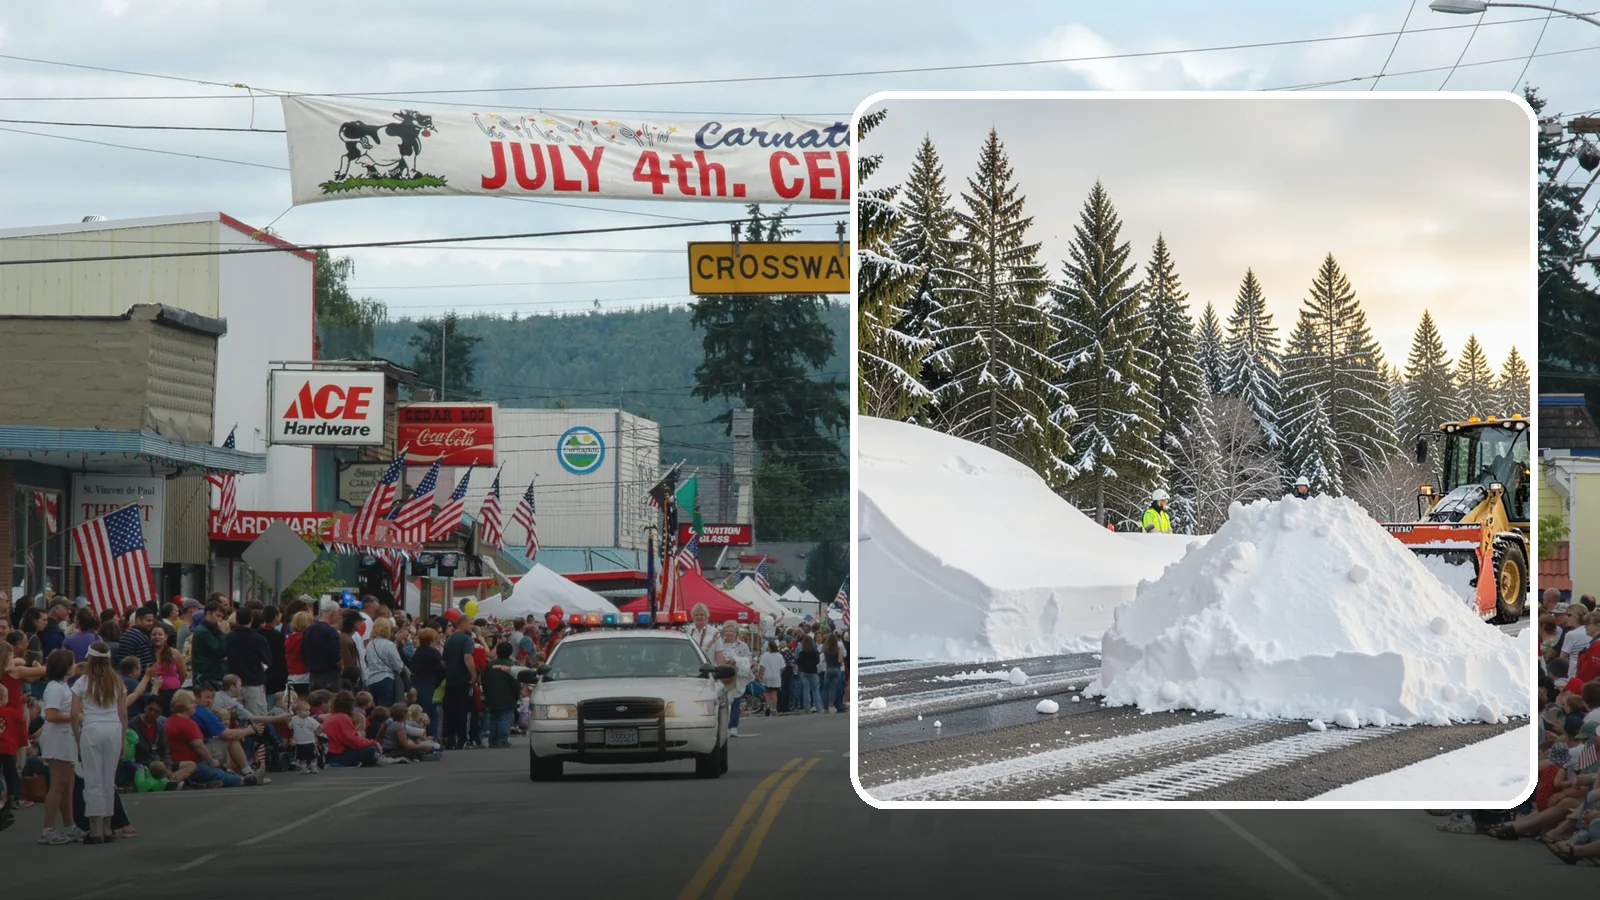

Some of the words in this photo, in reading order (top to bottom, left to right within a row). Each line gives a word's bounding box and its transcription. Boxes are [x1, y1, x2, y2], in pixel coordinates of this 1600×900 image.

[694, 121, 851, 150] Carnat
[481, 141, 604, 193] JULY
[632, 150, 747, 198] 4th.
[696, 254, 851, 280] CROSSWA
[282, 380, 374, 420] ACE
[405, 409, 453, 422] CEDAR
[283, 421, 371, 437] Hardware
[416, 428, 477, 447] Coca-Cola
[353, 467, 385, 480] Simpl
[95, 485, 124, 495] Vincent
[126, 486, 136, 495] de
[137, 486, 155, 496] Paul
[688, 526, 741, 535] CRNATION
[699, 535, 730, 543] GLASS
